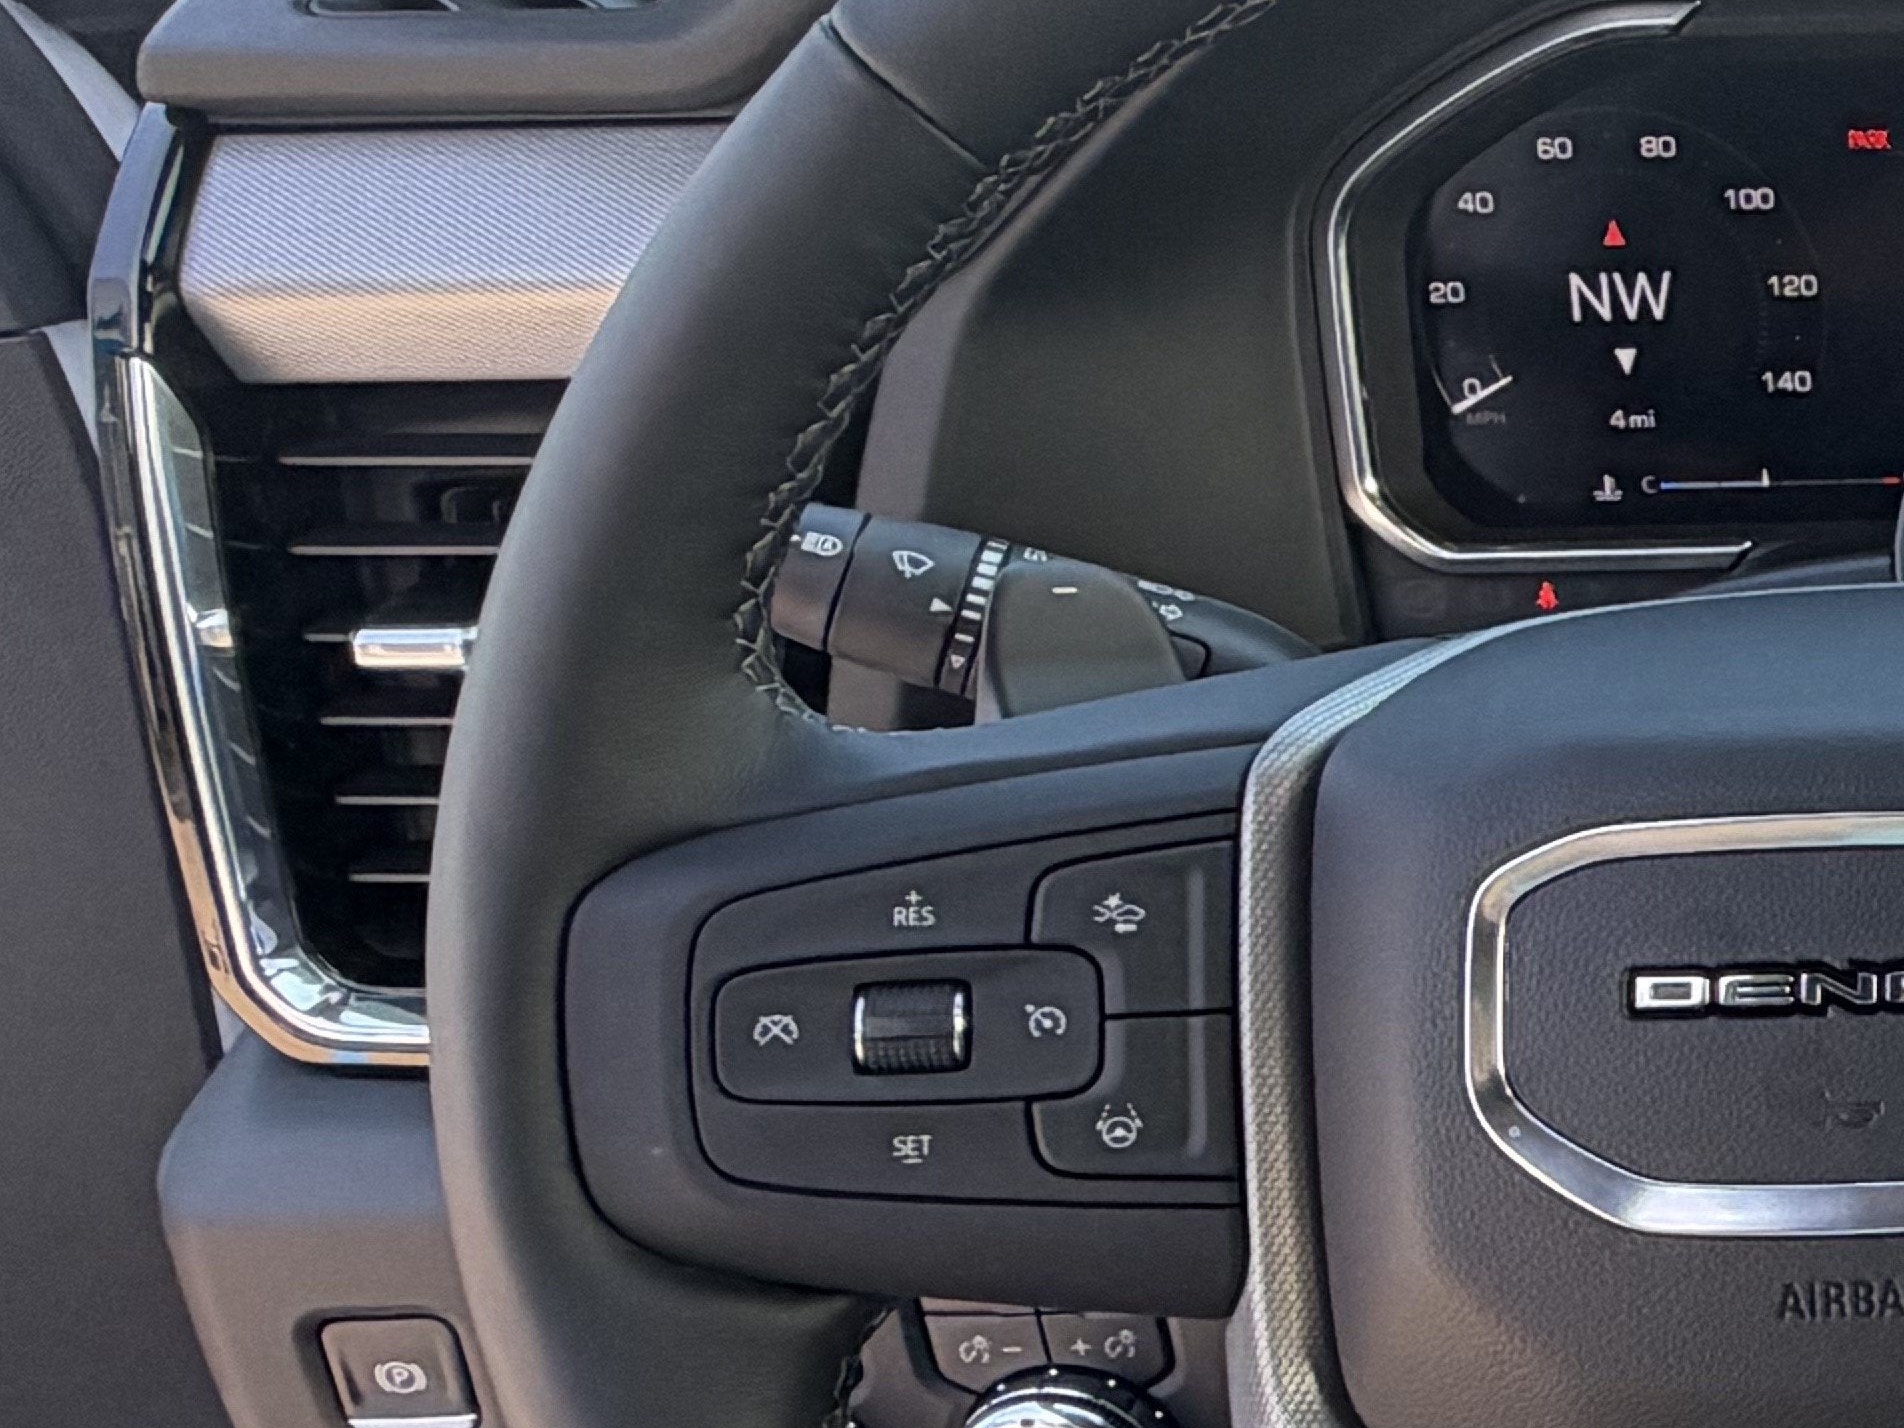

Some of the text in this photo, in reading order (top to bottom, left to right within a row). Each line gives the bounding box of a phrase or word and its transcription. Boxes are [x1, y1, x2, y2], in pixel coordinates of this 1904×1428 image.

[1537, 136, 1573, 160] 60
[1639, 135, 1677, 158] 80
[1457, 191, 1495, 214] 40
[1723, 187, 1775, 211] 100
[1428, 281, 1466, 305] 20
[1568, 270, 1672, 323] NW
[1767, 274, 1819, 298] 120
[1463, 378, 1481, 400] 0
[1761, 371, 1813, 394] 140
[1641, 475, 1657, 495] C
[893, 905, 936, 927] RES
[892, 1134, 932, 1158] SET
